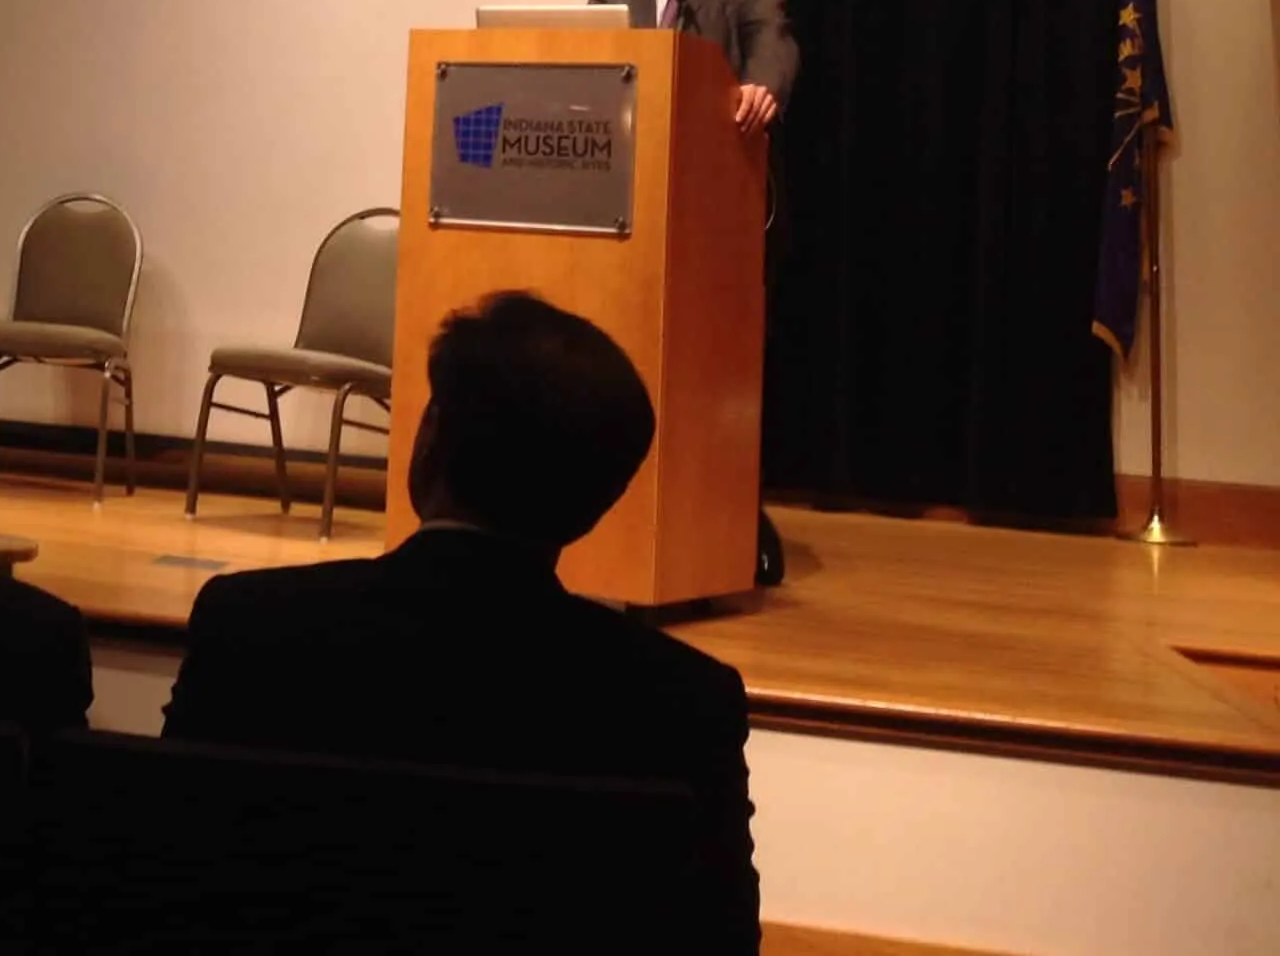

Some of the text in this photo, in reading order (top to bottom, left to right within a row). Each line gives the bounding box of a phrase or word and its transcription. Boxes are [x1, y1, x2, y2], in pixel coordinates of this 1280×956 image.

[503, 119, 612, 135] INDIANA STATE
[501, 135, 612, 159] MUSEUM
